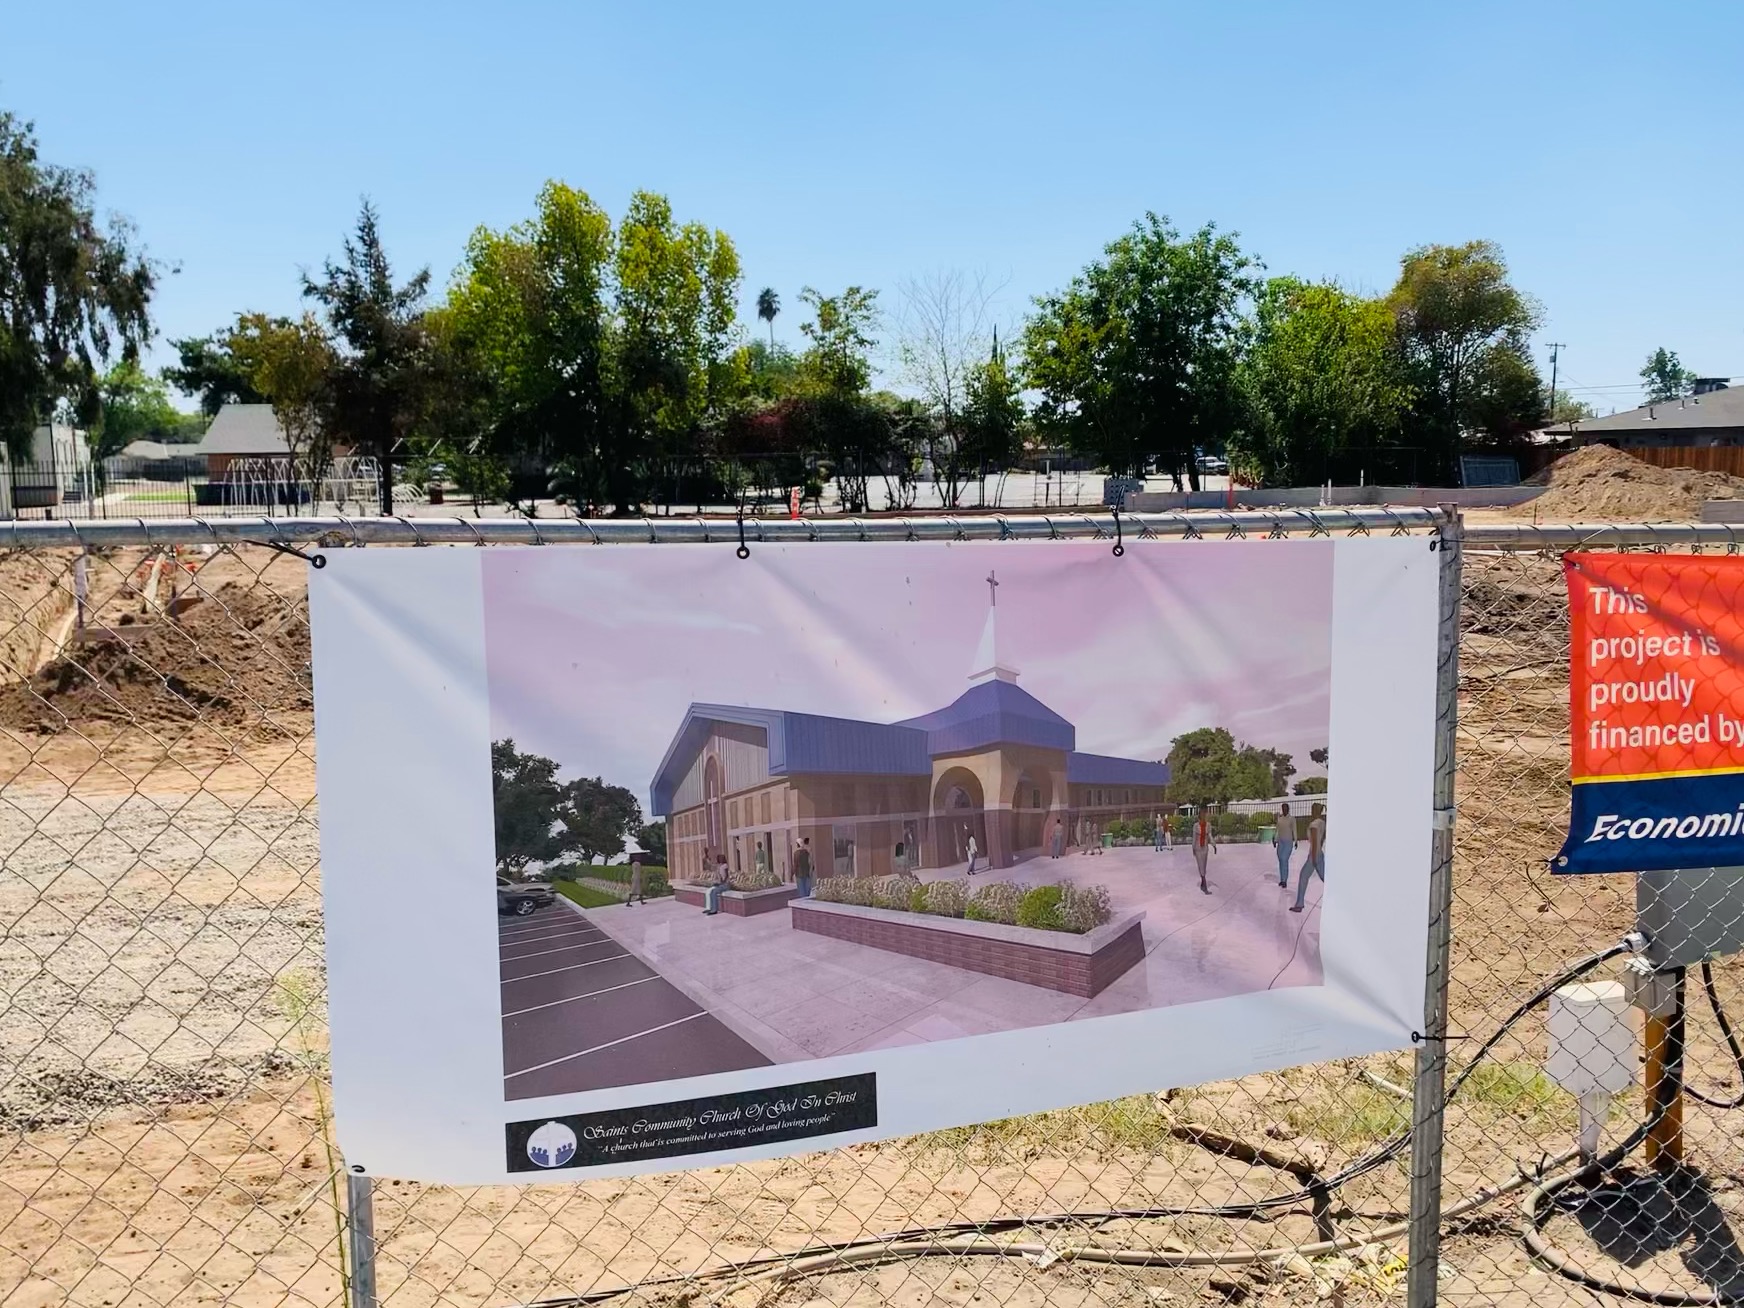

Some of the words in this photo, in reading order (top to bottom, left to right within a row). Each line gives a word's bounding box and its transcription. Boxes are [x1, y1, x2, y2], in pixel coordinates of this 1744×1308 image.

[1588, 585, 1648, 615] This
[1590, 630, 1693, 667] project
[1698, 628, 1721, 656] is
[1590, 671, 1695, 711] proudly
[1588, 714, 1710, 750] financed
[1718, 712, 1744, 748] by
[1584, 802, 1744, 844] Economi
[583, 1125, 629, 1139] Saints
[632, 1116, 697, 1133] Community
[700, 1107, 741, 1125] Church
[745, 1101, 768, 1121] Of
[766, 1098, 798, 1119] God
[800, 1094, 822, 1109] In
[825, 1090, 857, 1106] Christ
[610, 1140, 639, 1153] church
[656, 1138, 665, 1146] is
[666, 1131, 707, 1144] committed
[708, 1130, 717, 1140] to
[718, 1125, 747, 1138] serving
[748, 1122, 765, 1133] God
[766, 1119, 781, 1131] and
[781, 1115, 806, 1129] loving
